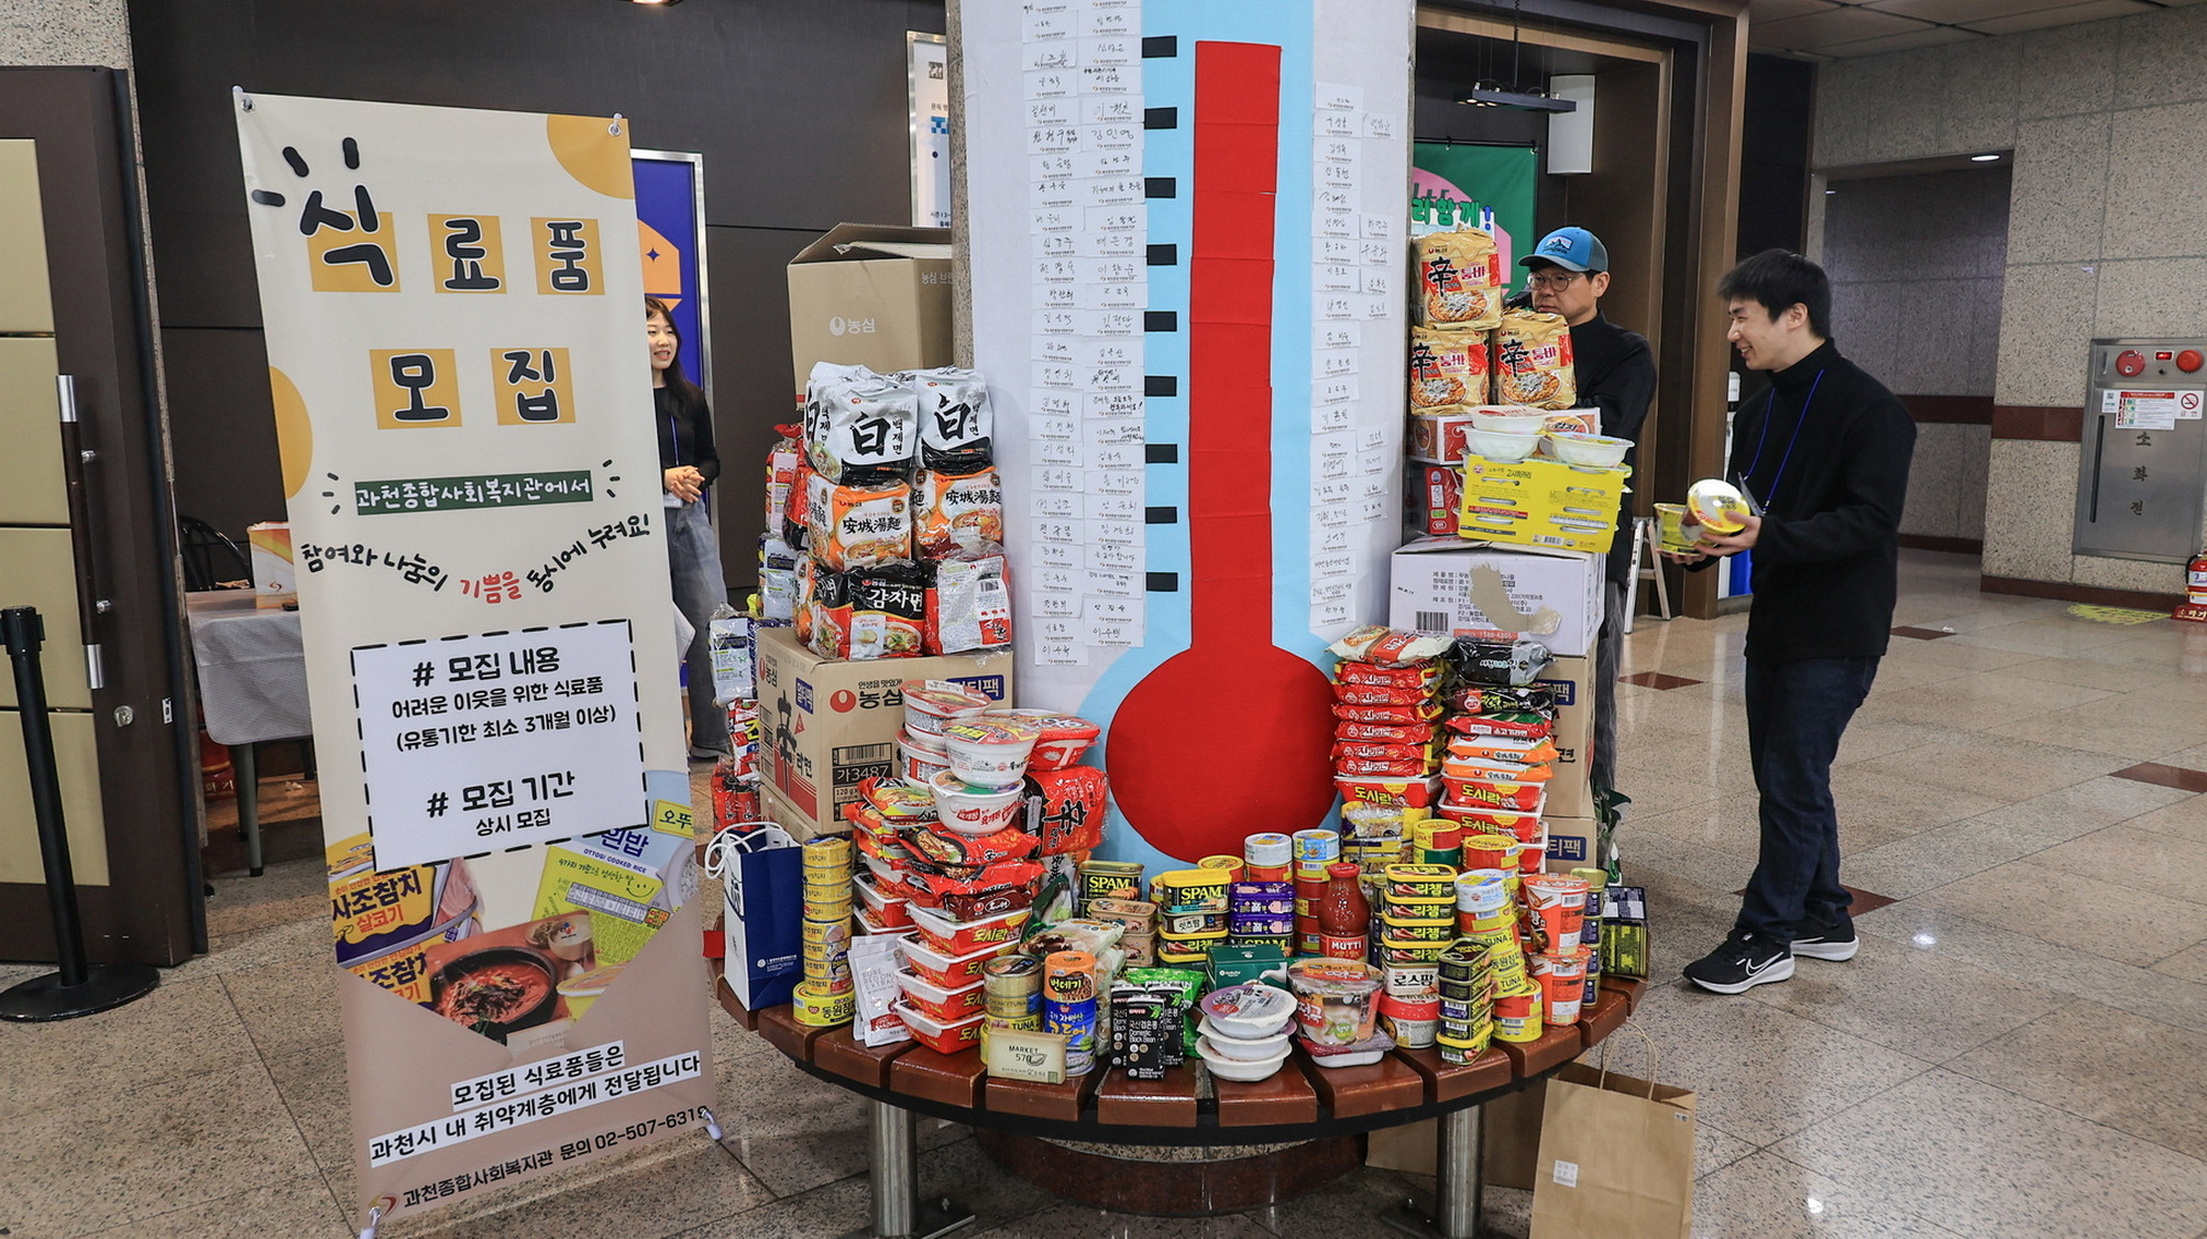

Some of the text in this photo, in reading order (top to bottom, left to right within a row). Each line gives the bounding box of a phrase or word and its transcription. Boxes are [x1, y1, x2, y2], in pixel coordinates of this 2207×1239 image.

[299, 184, 592, 292] 식료품
[1427, 256, 1459, 297] 辛
[847, 318, 876, 334] 농심
[1411, 342, 1437, 382] 辛
[1500, 338, 1529, 378] 辛
[388, 347, 560, 422] 모집
[356, 478, 591, 508] 과천종합사회복지관에서
[301, 513, 650, 604] 참여와 나눔의 기쁨을 동시에 누려요!
[867, 587, 923, 613] 감자면
[412, 647, 560, 687] # 모집 내용
[858, 681, 880, 690] 인생을
[957, 678, 999, 698] 티팩
[392, 676, 604, 719] 어려운 이웃을 위한 식료품
[858, 690, 904, 710] 농심
[396, 703, 617, 752] (유통기한 최소 3개월 이상)
[837, 765, 890, 782] 가3487
[426, 770, 575, 819] # 모집 기간
[1355, 786, 1392, 804] 도시락
[1462, 784, 1501, 806] 도시락
[475, 808, 551, 838] 상시 모집
[659, 809, 694, 829] 오뚜
[1461, 816, 1500, 836] 도시락
[1549, 836, 1581, 857] 티팩
[583, 848, 647, 874] OTTOGI COOKED RICE
[1089, 877, 1130, 890] SPAM
[1181, 886, 1223, 900] SPAM
[1416, 883, 1442, 897] 리챔
[331, 869, 423, 922] 사조참치
[356, 904, 404, 934] 살코기
[1413, 905, 1440, 919] 리챔
[973, 929, 1008, 942] 도시락
[1413, 927, 1440, 941] 리챔
[1332, 941, 1362, 950] MUTTI
[1412, 949, 1438, 963] 리챔
[1050, 979, 1082, 991] 번데기
[1501, 978, 1523, 988] TUNA
[1011, 1020, 1035, 1031] TUNA
[1008, 1045, 1039, 1055] MARKET
[1015, 1053, 1032, 1062] 570
[453, 1045, 624, 1106] 모집된 식료품들은
[371, 1054, 700, 1162] 과천시 내 취약계층에게 전달됩니다
[404, 1105, 709, 1209] 과천종합사회복지관 문의 02-507-6319
